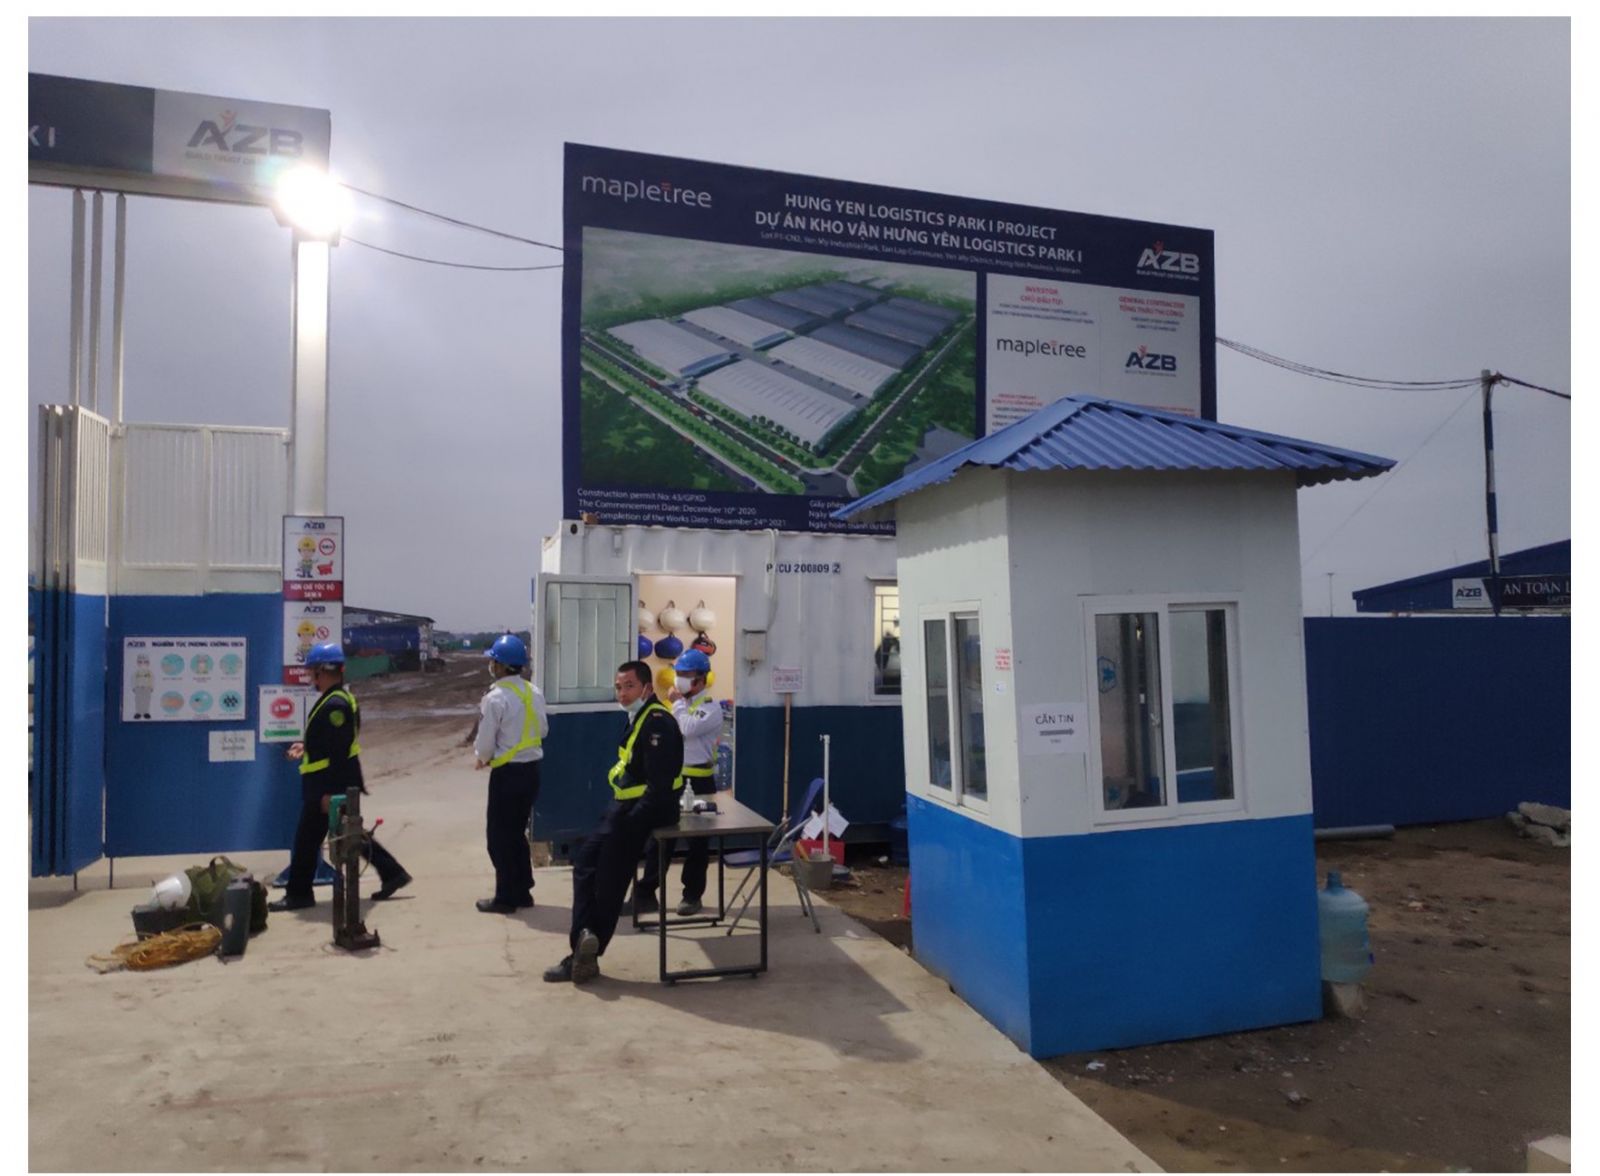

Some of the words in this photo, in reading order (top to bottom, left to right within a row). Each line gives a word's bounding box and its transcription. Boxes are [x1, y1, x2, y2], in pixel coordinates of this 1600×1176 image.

[187, 119, 303, 156] AZB
[582, 175, 712, 208] mapletree
[785, 193, 831, 212] HUNG
[835, 199, 865, 216] YEN
[869, 204, 944, 226] LOGISTICS
[948, 214, 986, 232] PARK
[989, 220, 993, 232] I
[997, 220, 1057, 240] PROJECT
[755, 211, 780, 230] DỰ
[783, 212, 806, 230] ÁN
[810, 217, 844, 234] KHO
[847, 220, 880, 240] VẬN
[883, 226, 928, 244] HƯNG
[931, 231, 960, 248] YÊN
[964, 237, 1036, 257] LOGISTICS
[1038, 246, 1076, 263] PARK
[1078, 251, 1082, 262] I
[1137, 246, 1199, 273] AZB
[996, 337, 1087, 358] mapletree
[1125, 350, 1176, 371] AZB
[577, 488, 629, 498] Construction
[630, 490, 656, 501] permit
[579, 499, 594, 508] The
[595, 499, 660, 510] Commencement
[683, 504, 722, 513] December
[642, 512, 651, 521] of
[652, 512, 663, 521] the
[714, 516, 752, 525] November
[766, 563, 791, 573] PCU
[833, 562, 840, 573] 2
[1455, 587, 1482, 598] AZB
[1503, 582, 1520, 595] AN
[1035, 713, 1056, 725] CĂN
[1058, 714, 1074, 723] TIN
